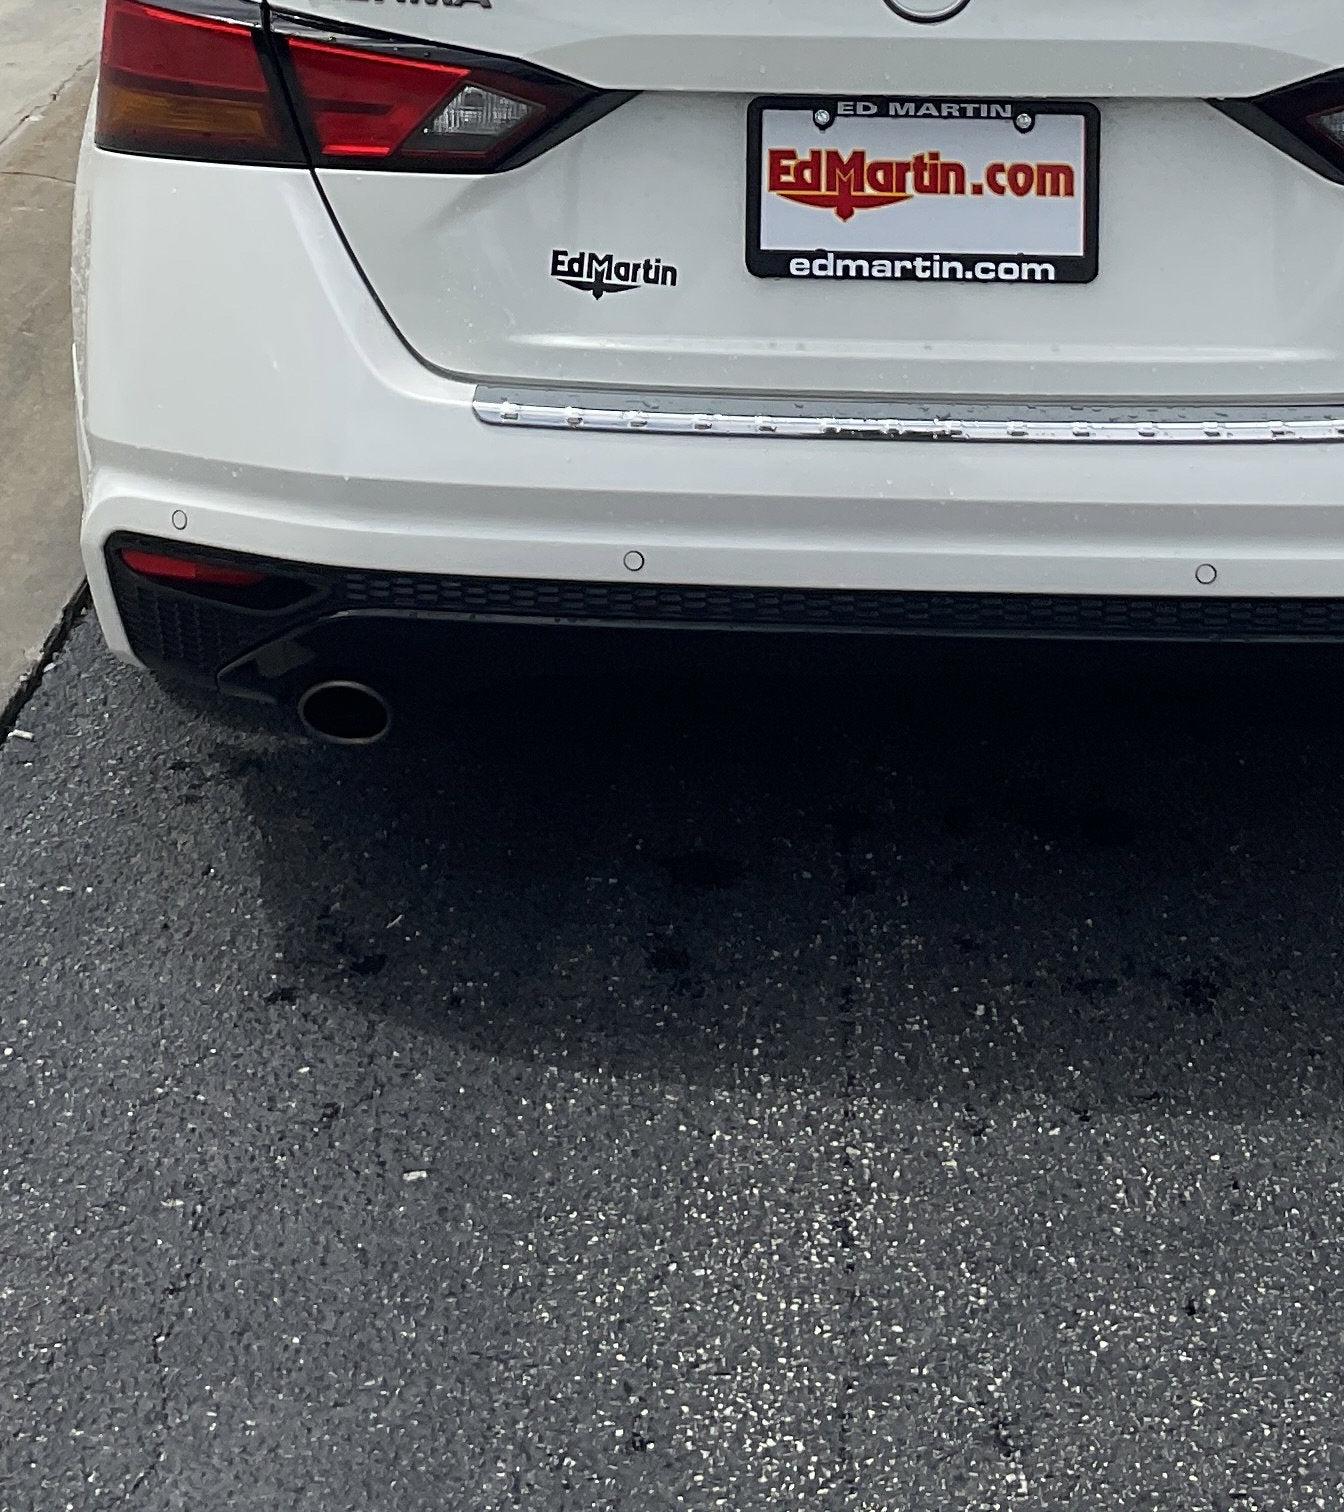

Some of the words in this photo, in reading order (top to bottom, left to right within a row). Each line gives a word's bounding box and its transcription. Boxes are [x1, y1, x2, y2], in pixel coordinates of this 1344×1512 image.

[837, 101, 878, 117] ED
[888, 102, 1013, 118] MARTIN
[768, 148, 1075, 208] EdMartin.com
[789, 252, 1056, 281] edmartin.com
